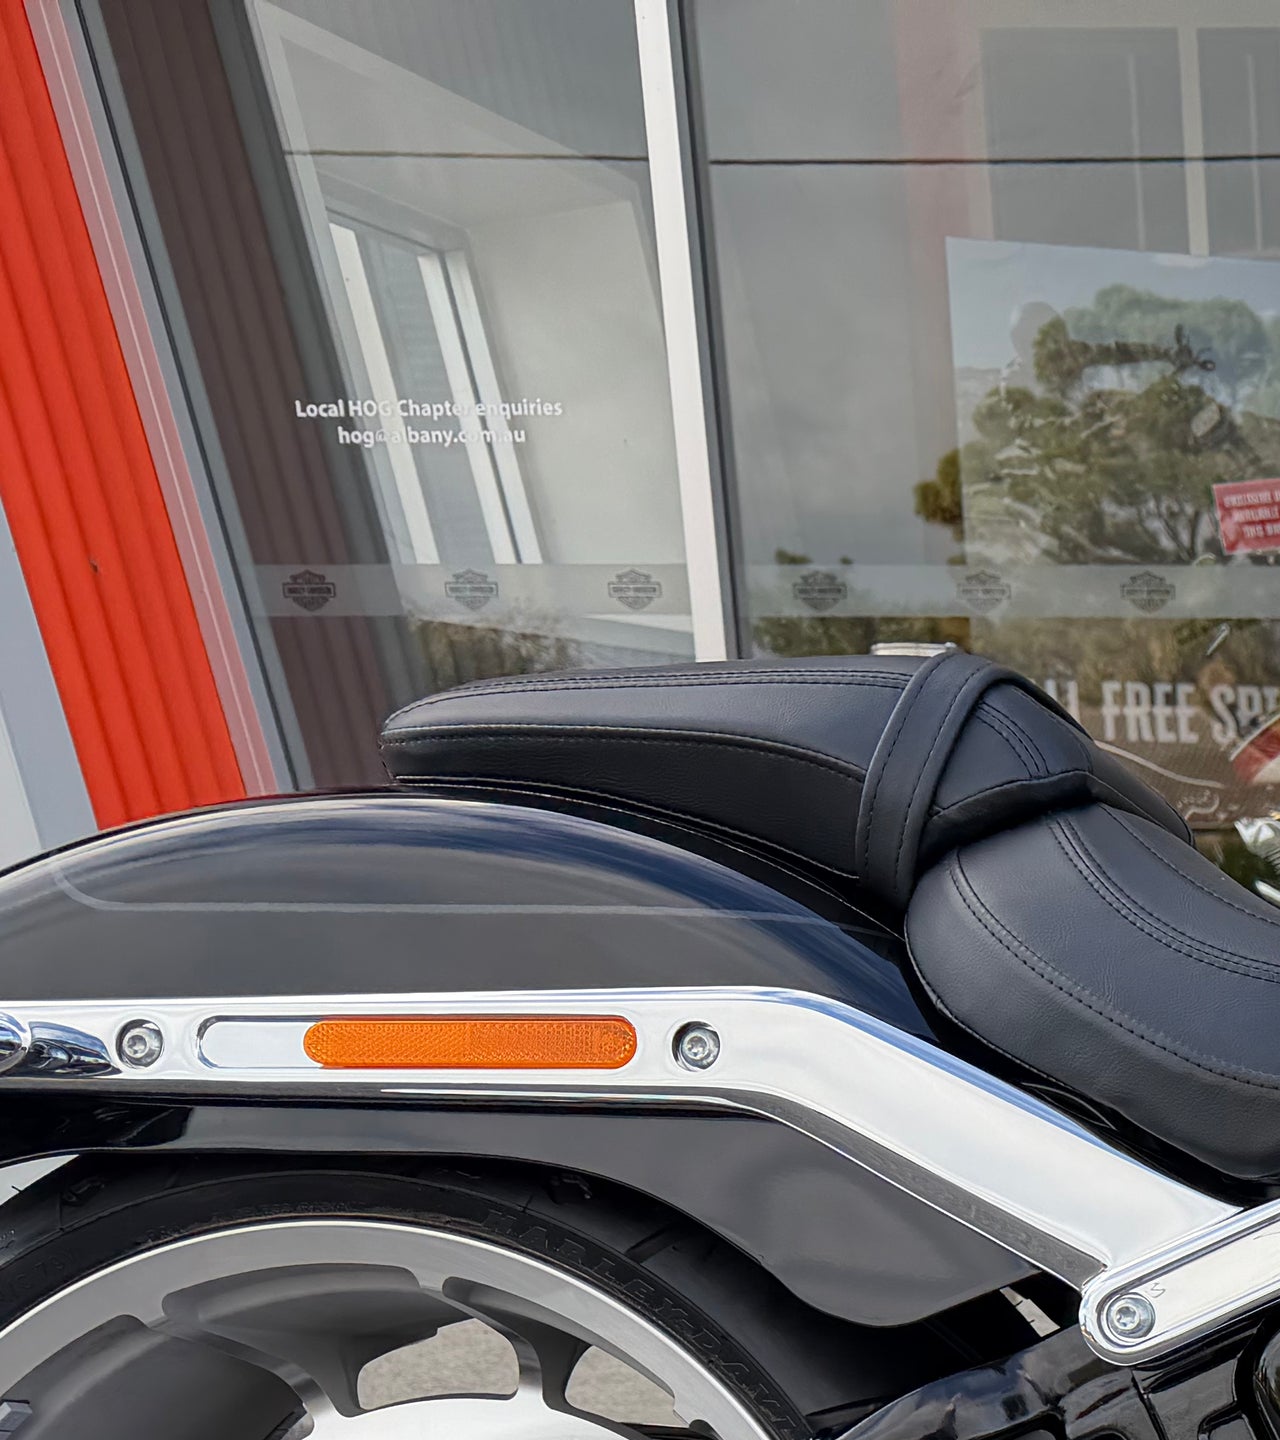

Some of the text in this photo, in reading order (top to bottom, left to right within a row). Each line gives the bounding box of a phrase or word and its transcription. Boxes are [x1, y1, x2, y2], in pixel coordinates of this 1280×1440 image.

[295, 400, 345, 418] Local
[349, 400, 393, 418] HOG
[477, 400, 563, 423] enquiries
[1101, 680, 1199, 744] FREE
